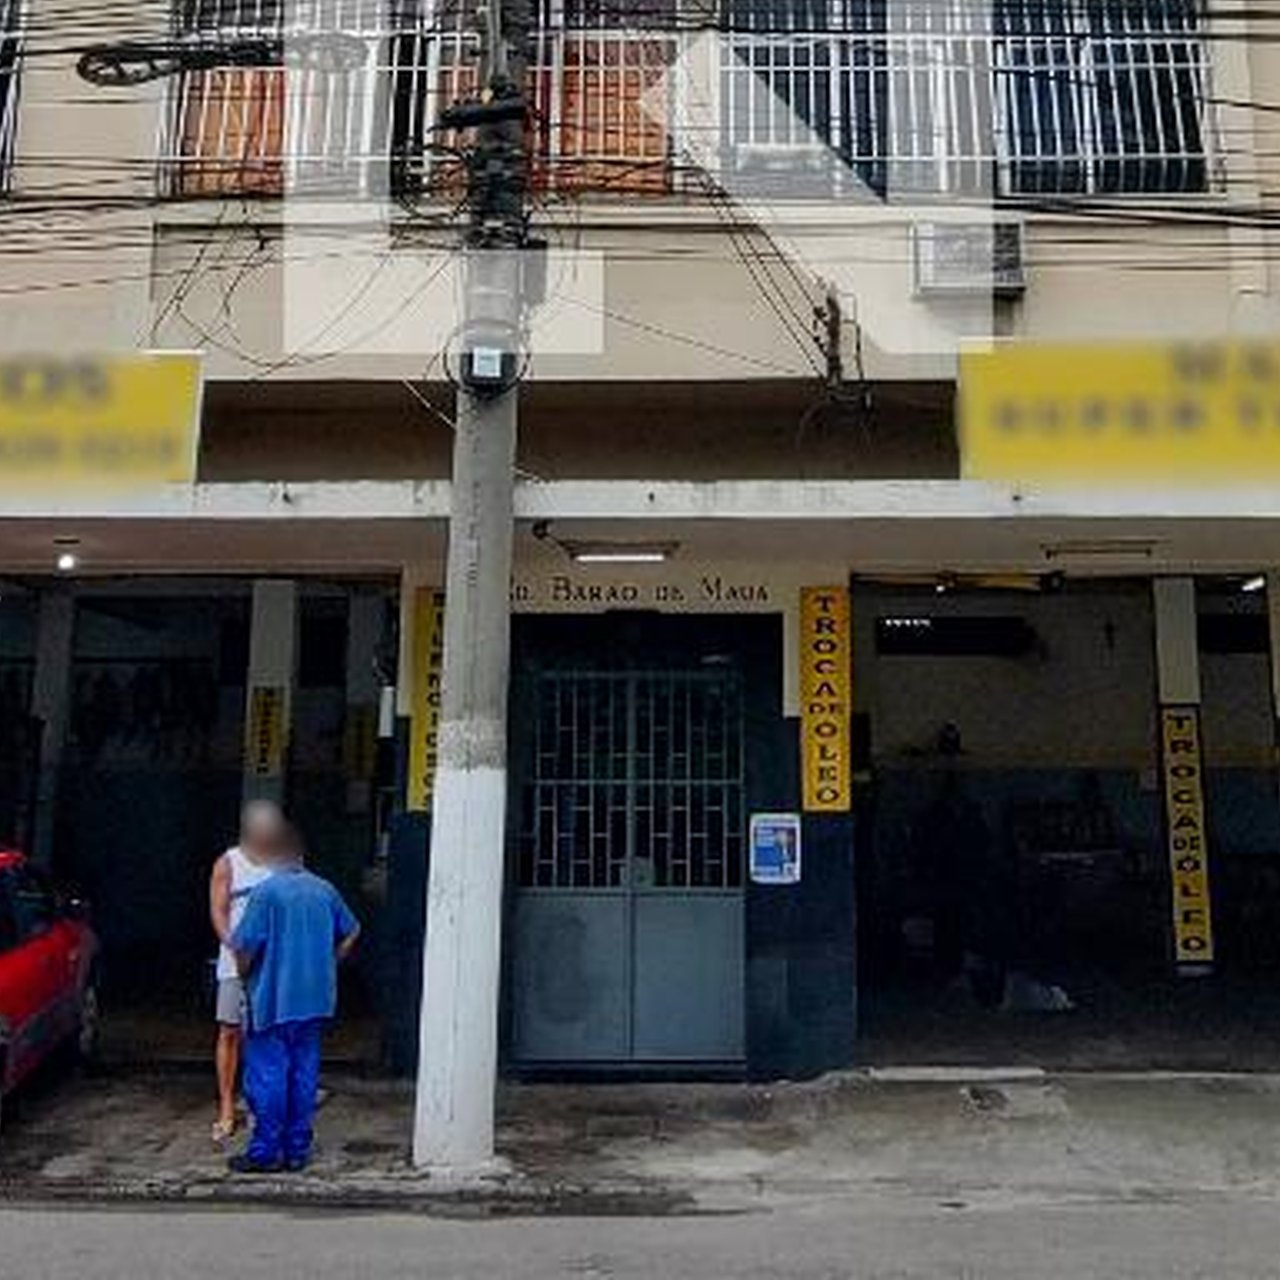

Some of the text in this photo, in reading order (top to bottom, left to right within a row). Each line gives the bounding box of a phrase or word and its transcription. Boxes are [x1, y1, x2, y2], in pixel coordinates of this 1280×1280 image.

[812, 596, 838, 697] TROCA
[1167, 715, 1197, 829] TROCA
[1173, 836, 1201, 851] DE
